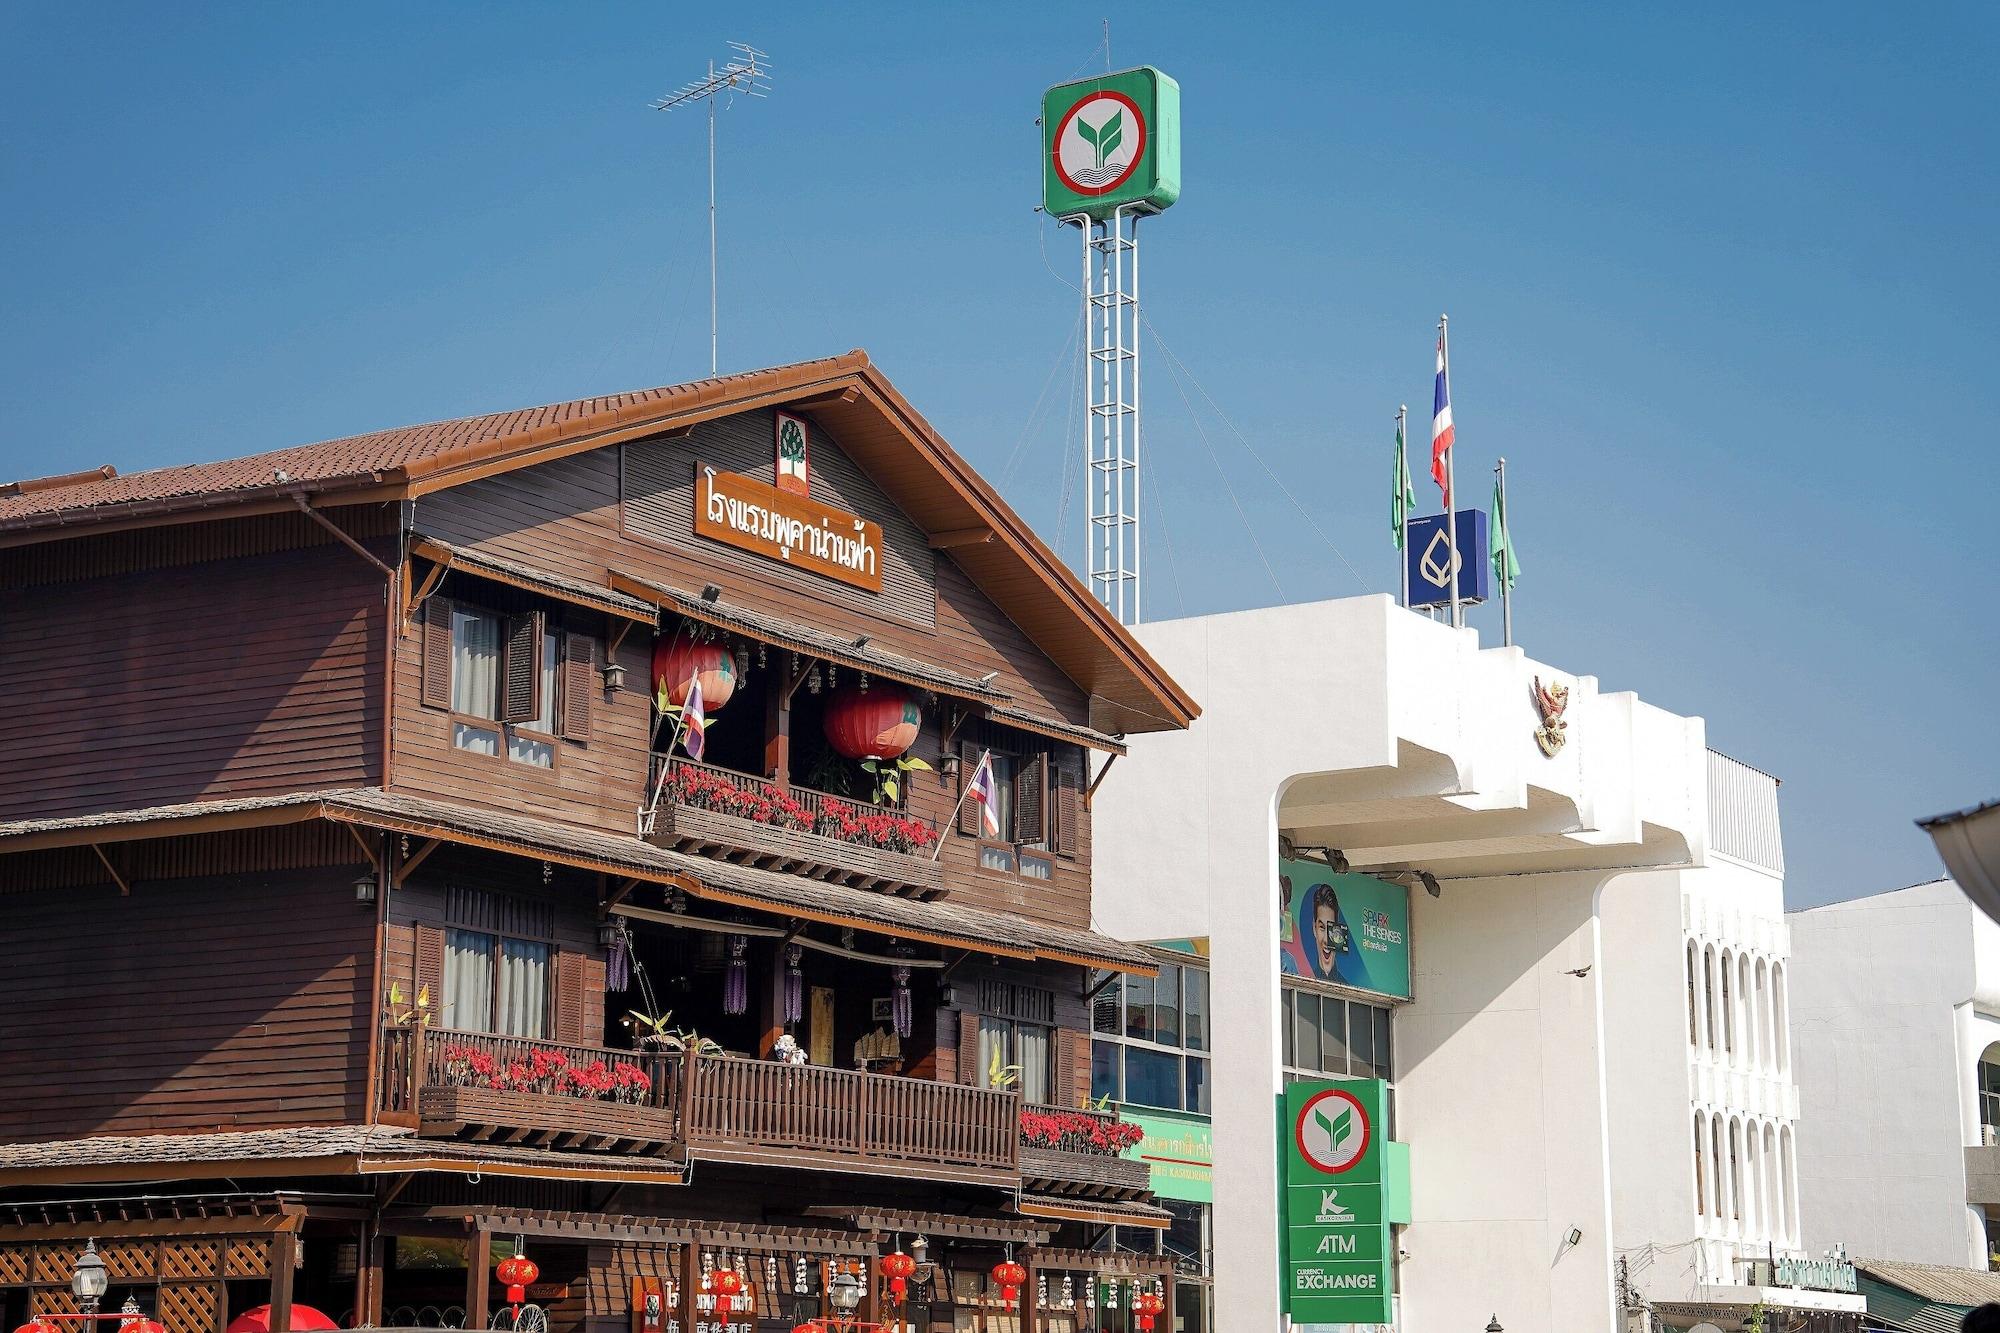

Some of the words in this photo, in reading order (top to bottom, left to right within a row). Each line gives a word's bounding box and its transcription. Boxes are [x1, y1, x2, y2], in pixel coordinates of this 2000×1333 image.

[703, 465, 875, 576] โรงแรมพูคาน่านฟ้า
[1362, 907, 1389, 926] SPARK
[1362, 923, 1376, 938] THE
[1376, 927, 1402, 944] SENSES
[1321, 1188, 1349, 1215] K
[1316, 1235, 1356, 1254] ATM
[1296, 1274, 1377, 1289] EXCHANGE
